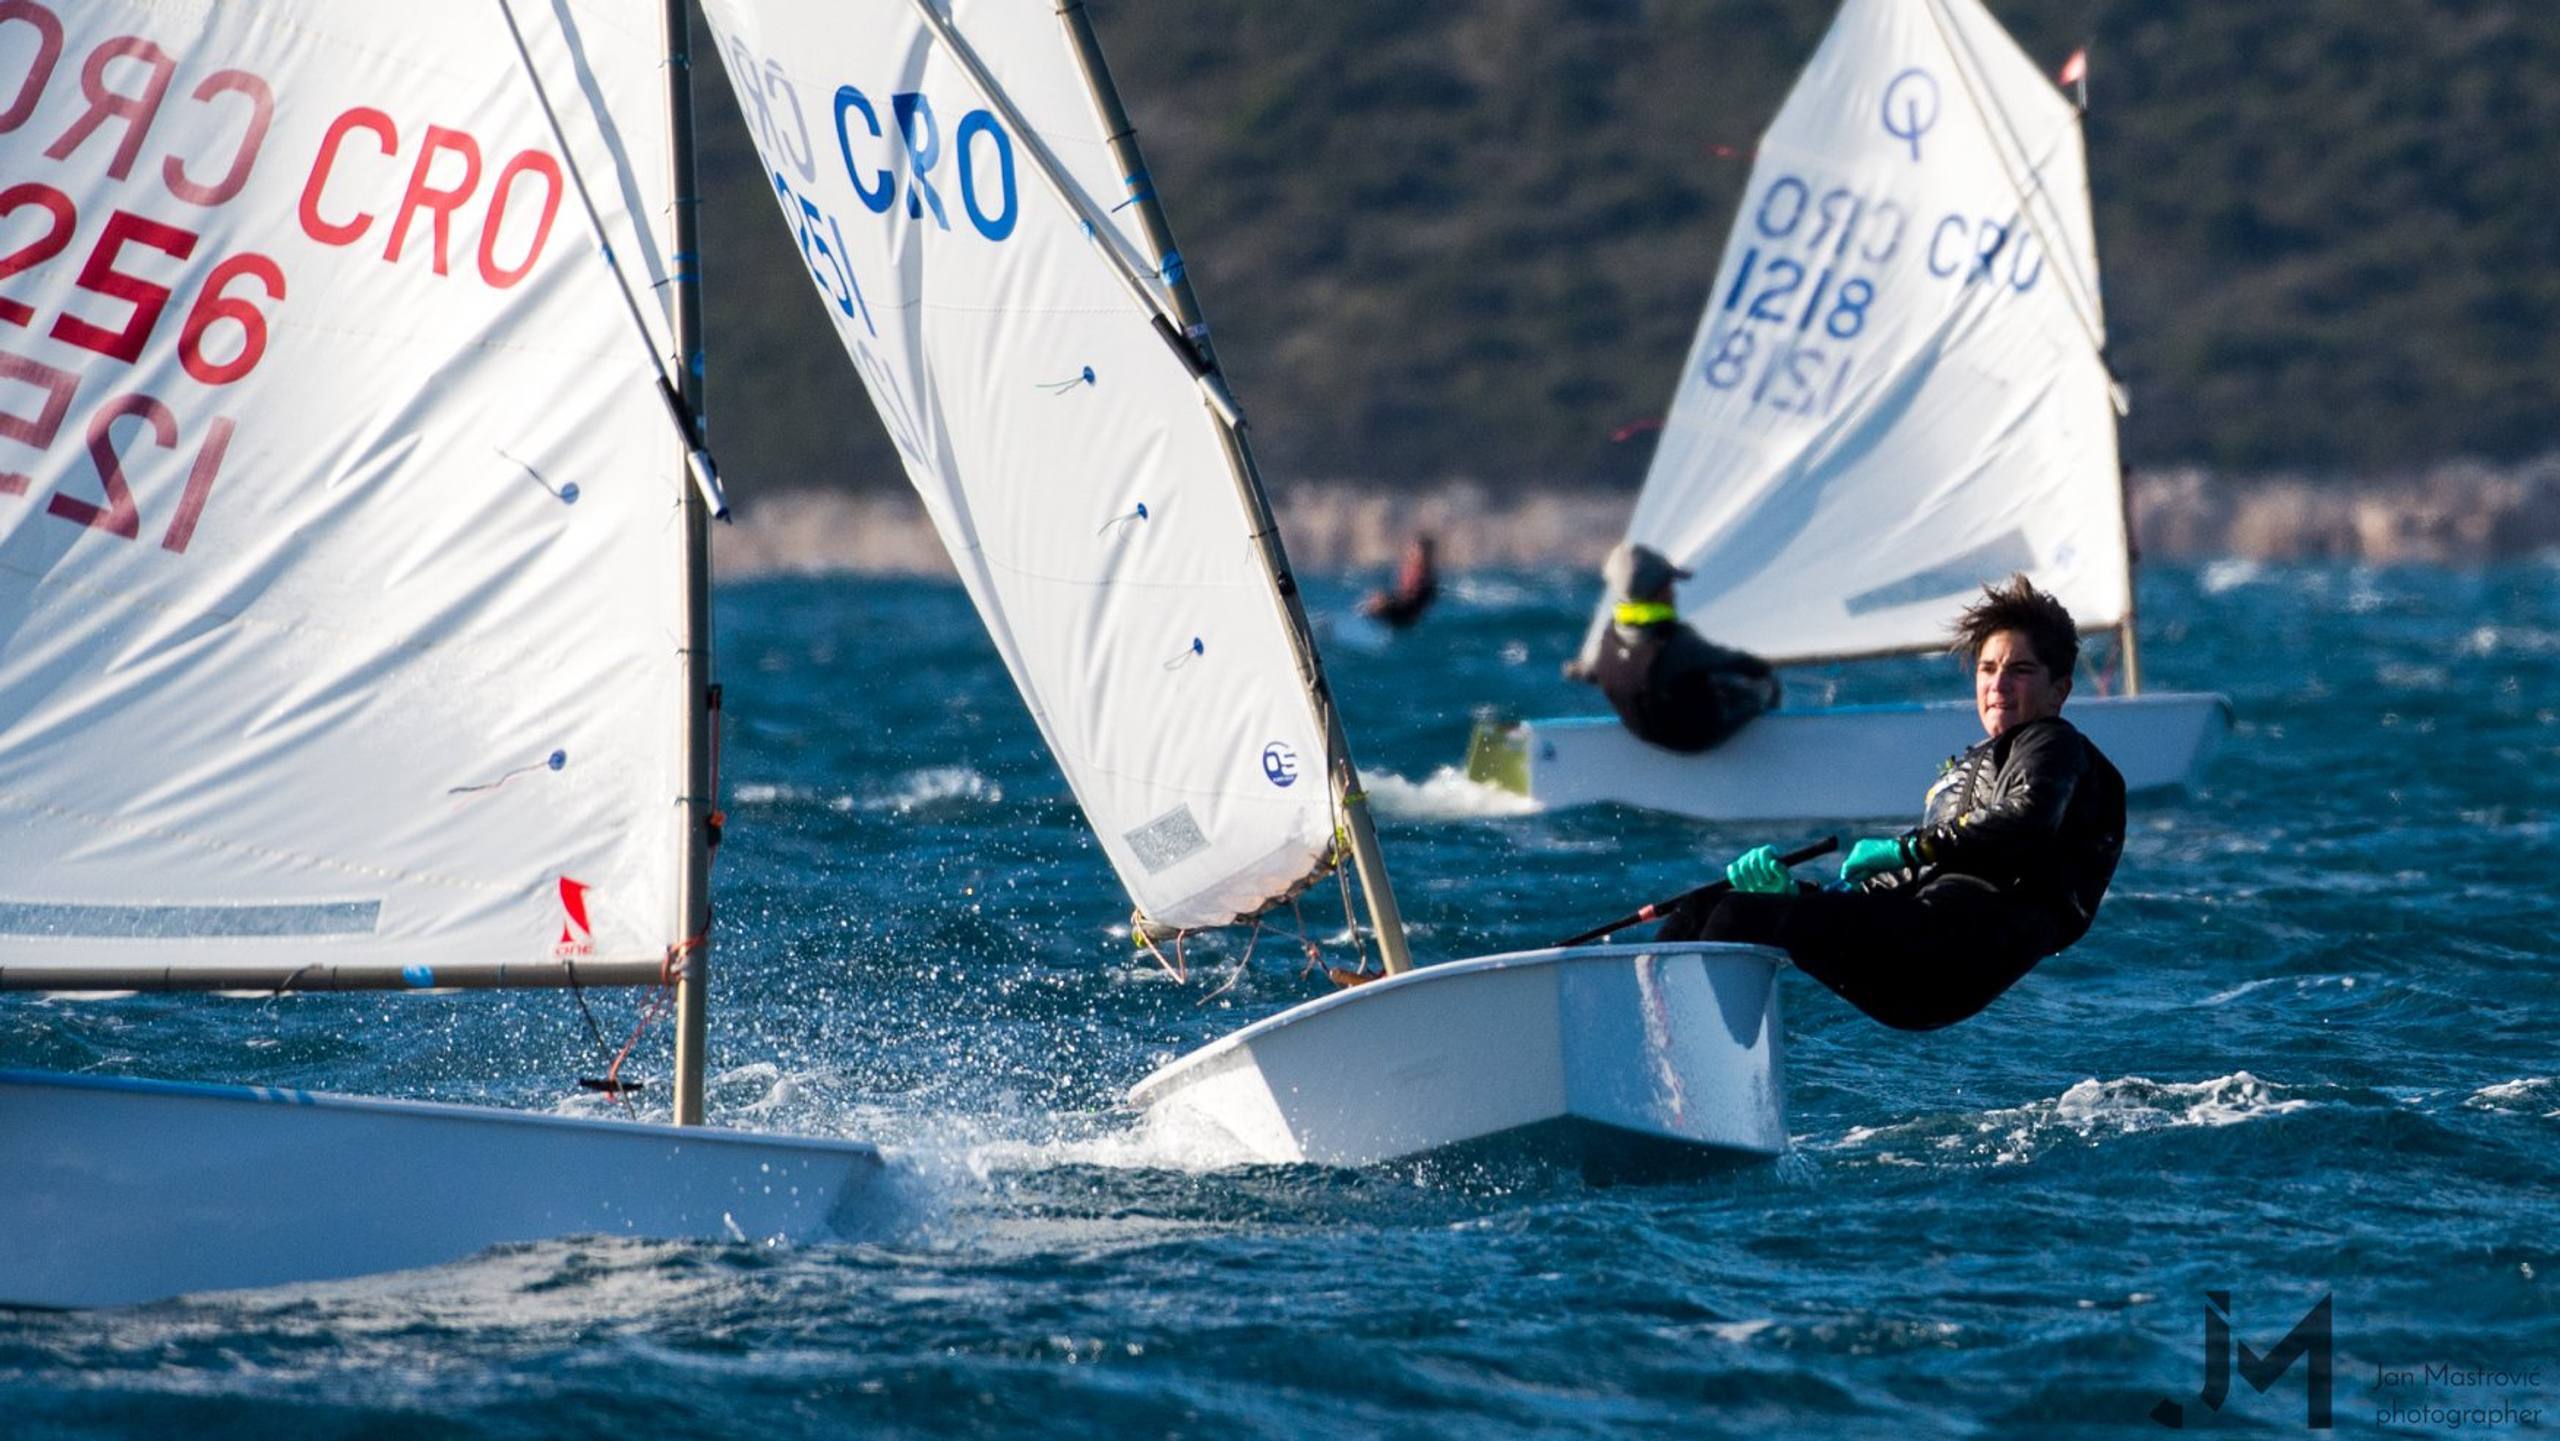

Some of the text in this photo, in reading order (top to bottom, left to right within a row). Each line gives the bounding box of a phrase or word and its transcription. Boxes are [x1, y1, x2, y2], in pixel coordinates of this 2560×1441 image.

[299, 106, 563, 289] CRO
[834, 85, 1018, 242] CRO
[0, 182, 286, 386] 256
[1725, 247, 1875, 339] 1218
[1928, 213, 2044, 294] CRO
